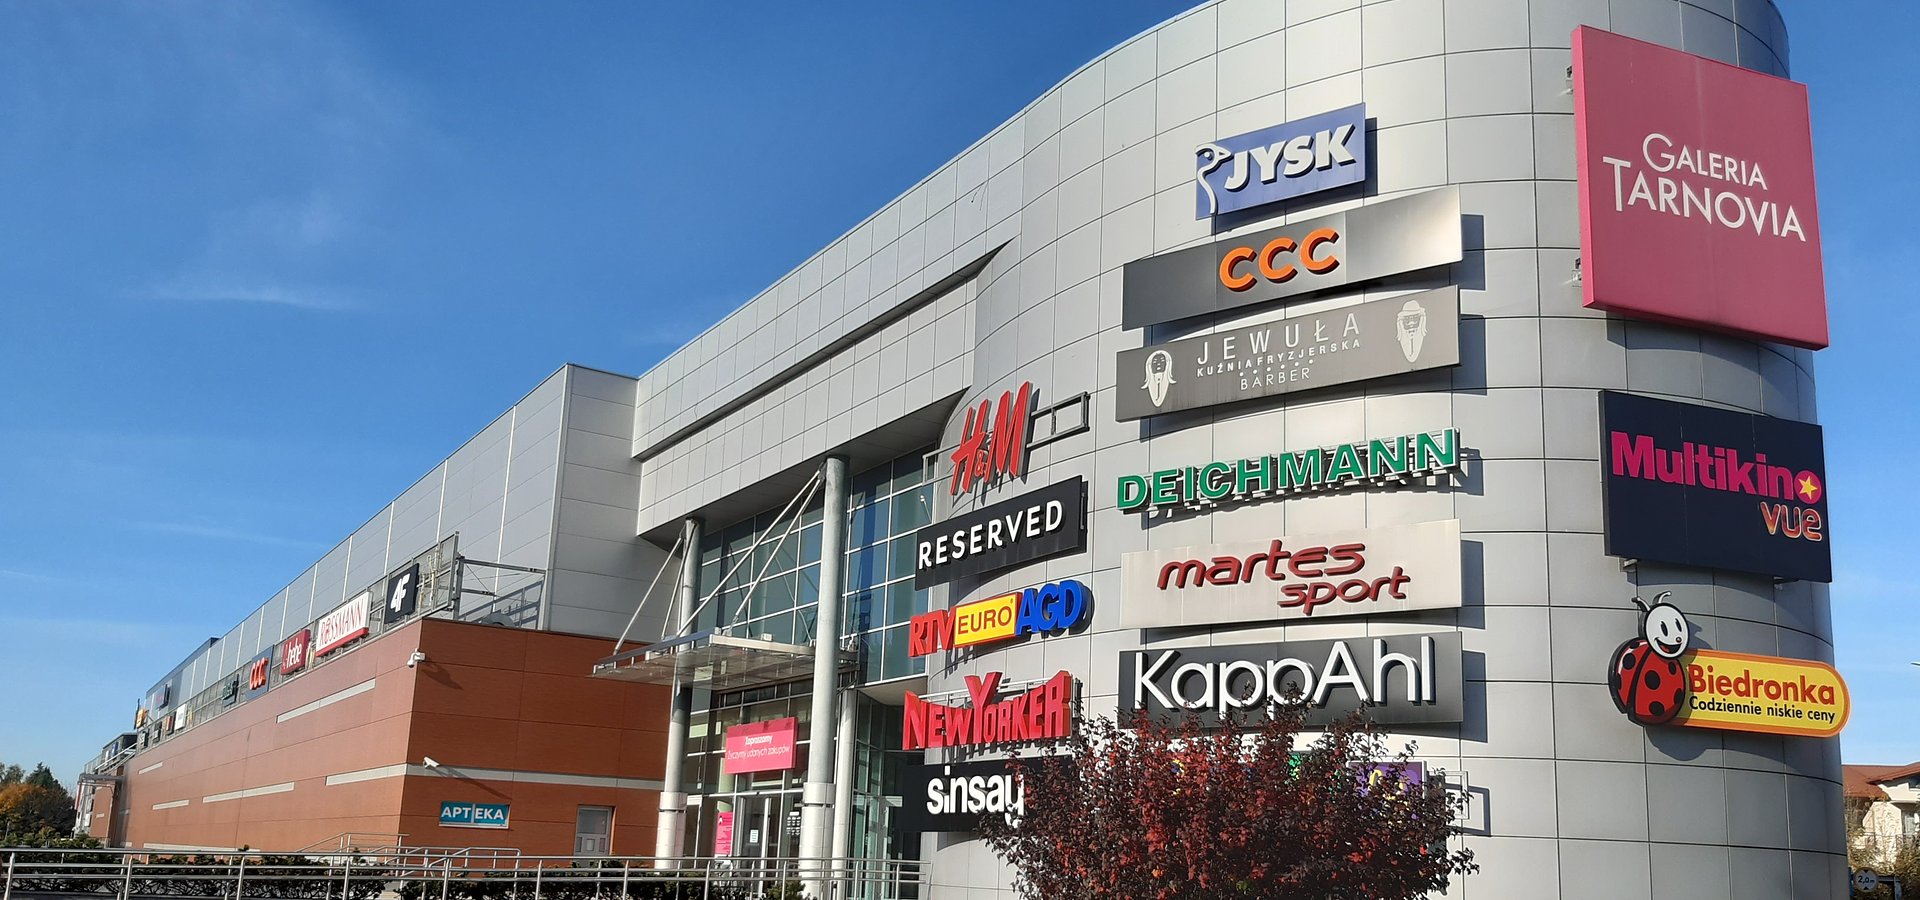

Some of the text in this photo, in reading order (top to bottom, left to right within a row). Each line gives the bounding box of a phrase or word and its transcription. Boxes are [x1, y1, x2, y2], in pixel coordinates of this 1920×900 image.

[1224, 123, 1357, 191] JYSK
[1642, 132, 1768, 190] GALERIA
[1602, 156, 1807, 242] TARNOVIA
[1219, 227, 1340, 292] CCC
[1197, 312, 1361, 365] JEWUŁA
[1197, 338, 1361, 378] KUŹNIA FRYZJERSKA
[1240, 366, 1310, 390] BARBER
[950, 380, 1033, 496] H&M
[1117, 427, 1460, 510] DEICHMANN
[1611, 431, 1822, 504] Multikino
[918, 500, 1064, 570] RESERVED
[1760, 501, 1822, 541] vue
[1157, 539, 1366, 590] martes
[1277, 566, 1411, 616] sport
[909, 579, 1087, 657] RTV EURO AGD
[1134, 635, 1437, 720] KappAhl
[1687, 663, 1835, 705] Biedronka
[1689, 695, 1836, 724] Codziennie niskie ceny
[926, 765, 1025, 829] sinsay
